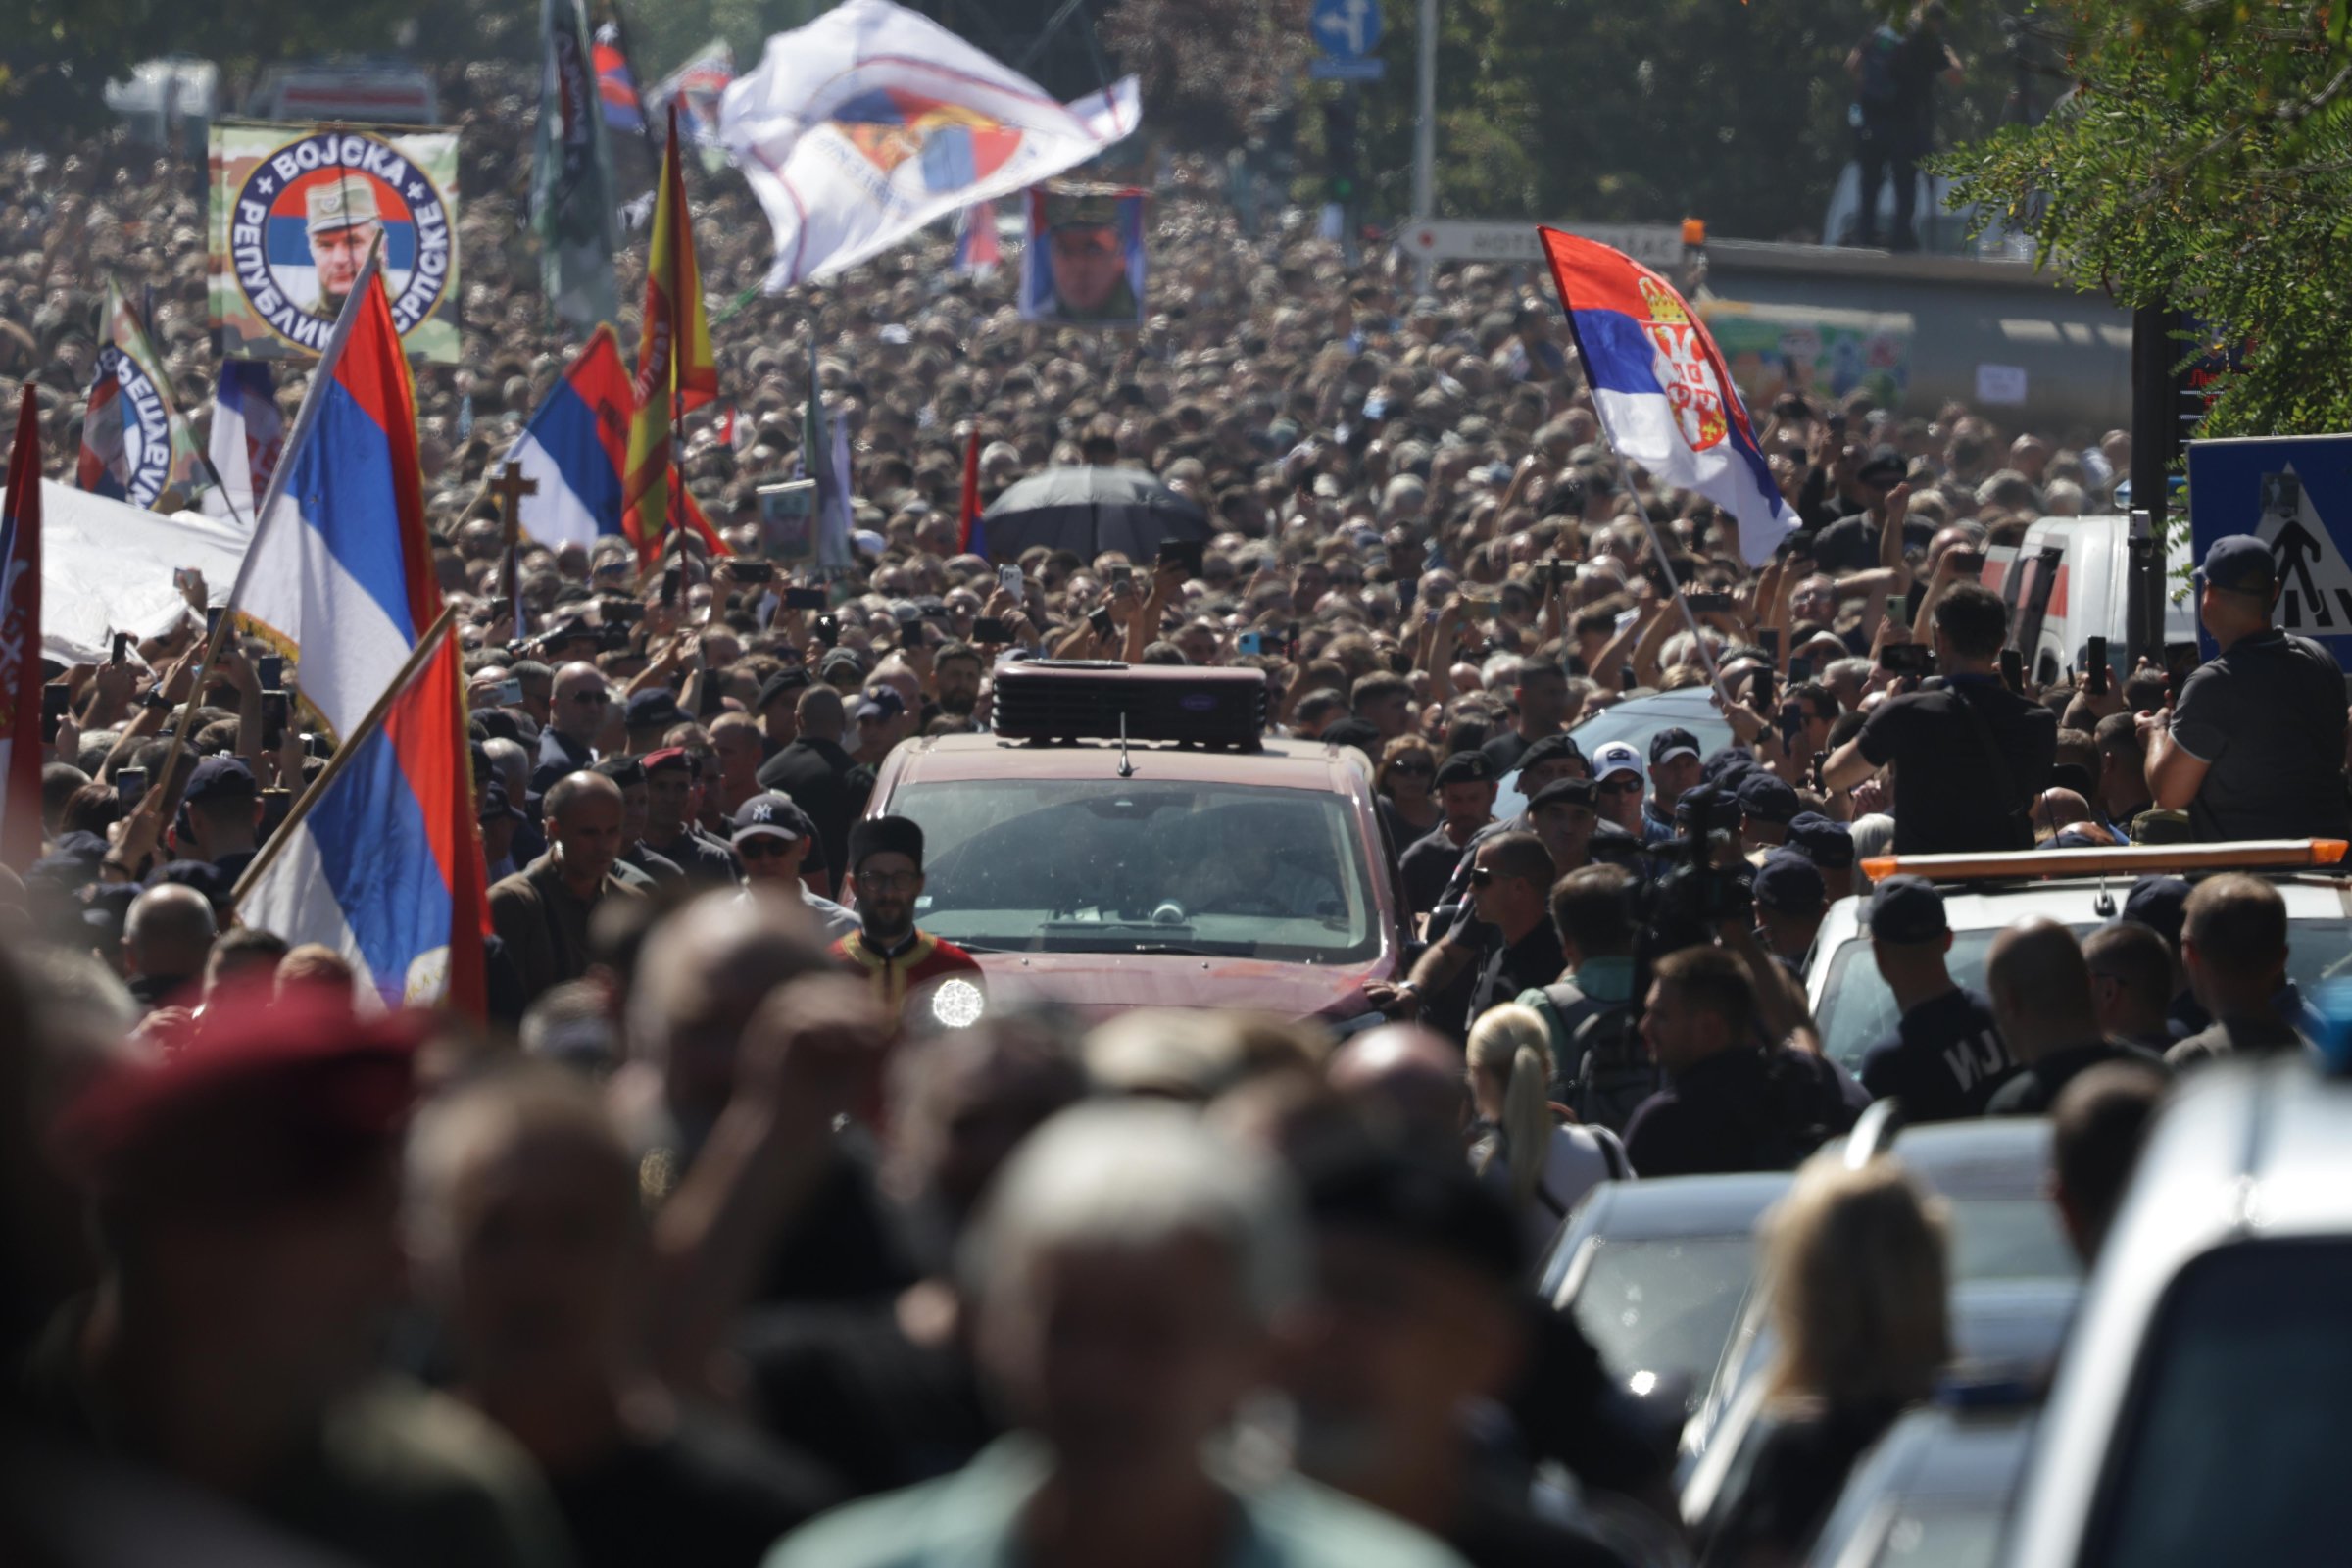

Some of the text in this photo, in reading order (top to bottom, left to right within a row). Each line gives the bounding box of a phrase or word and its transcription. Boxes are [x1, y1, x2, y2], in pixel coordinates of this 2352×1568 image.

[272, 135, 407, 187] ВОЈСКА
[1472, 231, 1539, 253] HOTE
[234, 199, 336, 350] РЕПУБЛИК
